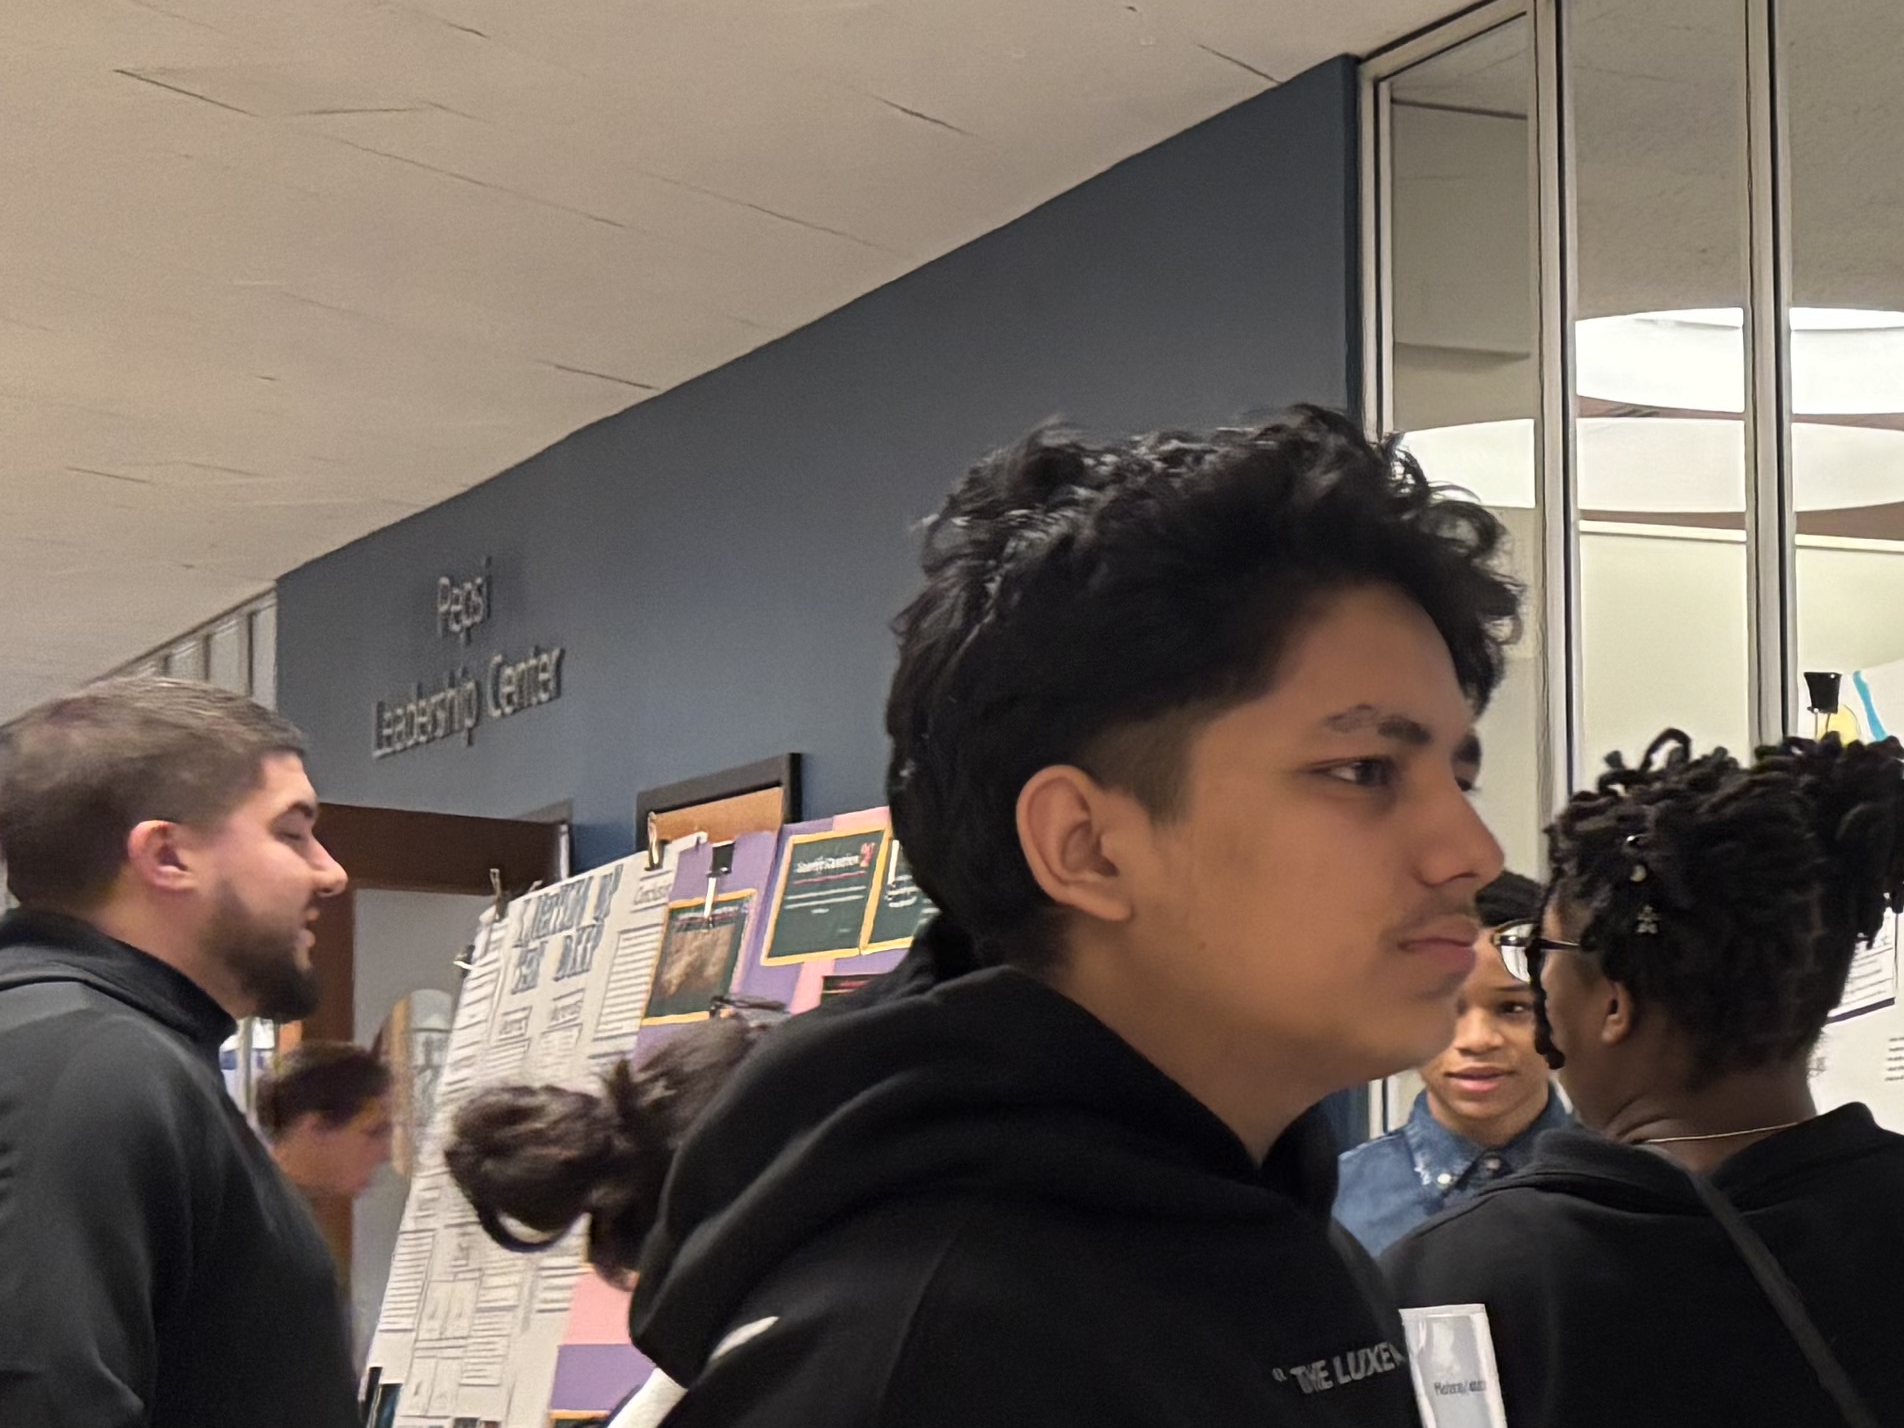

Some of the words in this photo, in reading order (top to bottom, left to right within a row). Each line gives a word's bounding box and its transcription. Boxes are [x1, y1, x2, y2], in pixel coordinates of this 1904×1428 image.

[436, 557, 492, 644] Pepsi
[371, 669, 478, 758] Leadership
[488, 644, 565, 718] Center
